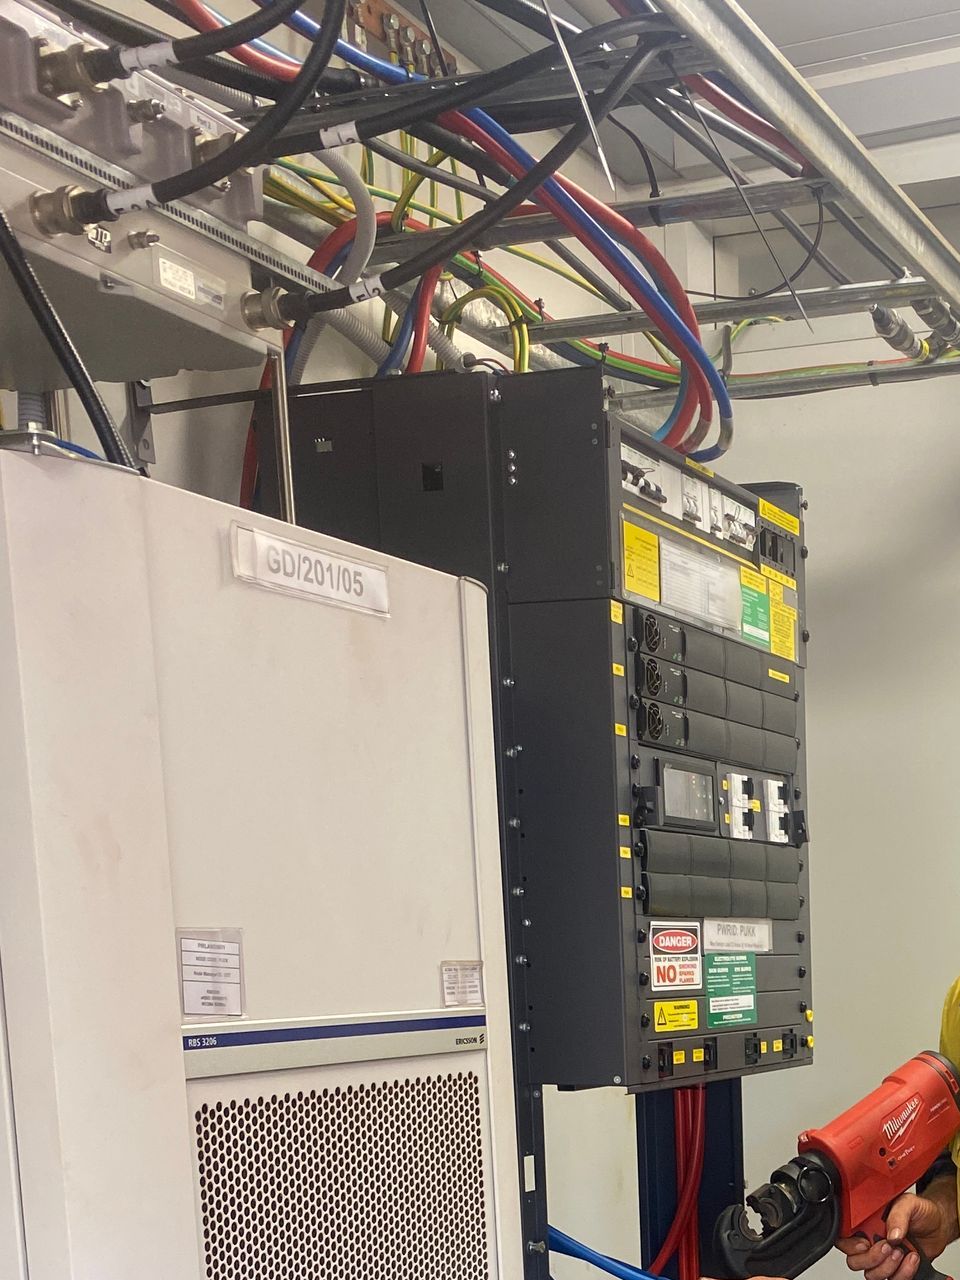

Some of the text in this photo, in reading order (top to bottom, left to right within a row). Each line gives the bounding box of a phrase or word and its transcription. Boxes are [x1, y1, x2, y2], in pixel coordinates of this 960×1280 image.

[266, 545, 364, 597] GD/201/05
[659, 935, 693, 947] DANGER
[656, 965, 677, 984] NO
[188, 1037, 217, 1048] RBS 3206
[455, 1036, 477, 1046] ERICSSON
[882, 1097, 920, 1140] Milwaukee
